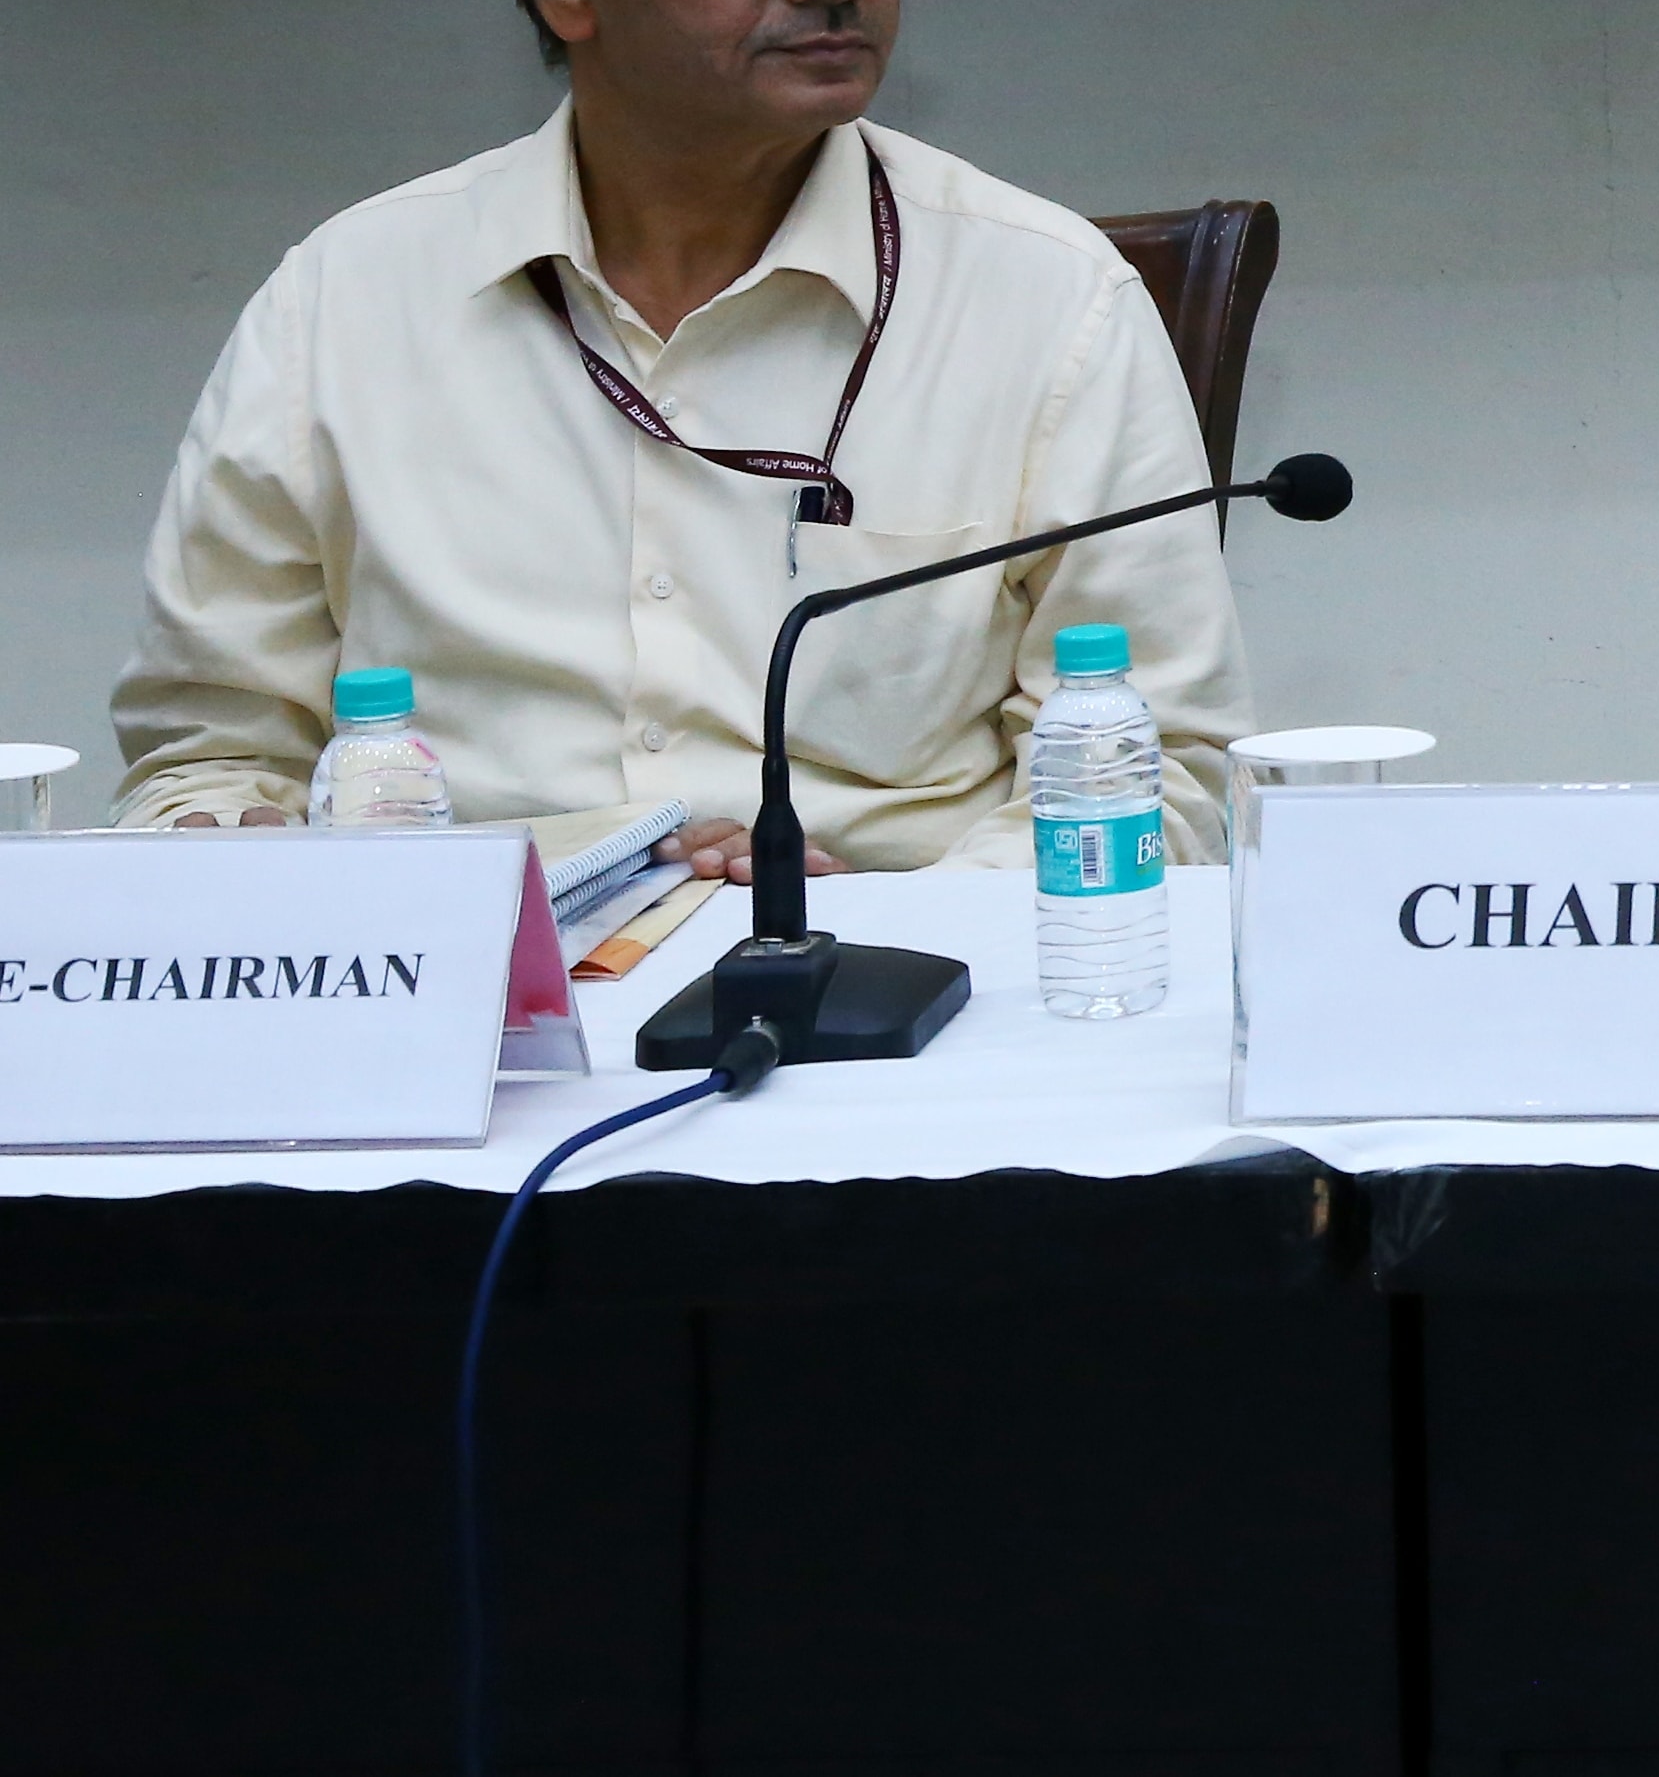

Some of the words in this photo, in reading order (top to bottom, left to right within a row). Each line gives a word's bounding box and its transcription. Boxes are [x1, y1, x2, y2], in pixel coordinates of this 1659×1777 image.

[882, 233, 894, 267] Ministry
[596, 368, 626, 401] Ministry
[745, 457, 780, 470] Affairs
[782, 459, 815, 473] Home
[817, 466, 828, 474] of
[0, 953, 426, 1004] E-CHAIRMAN
